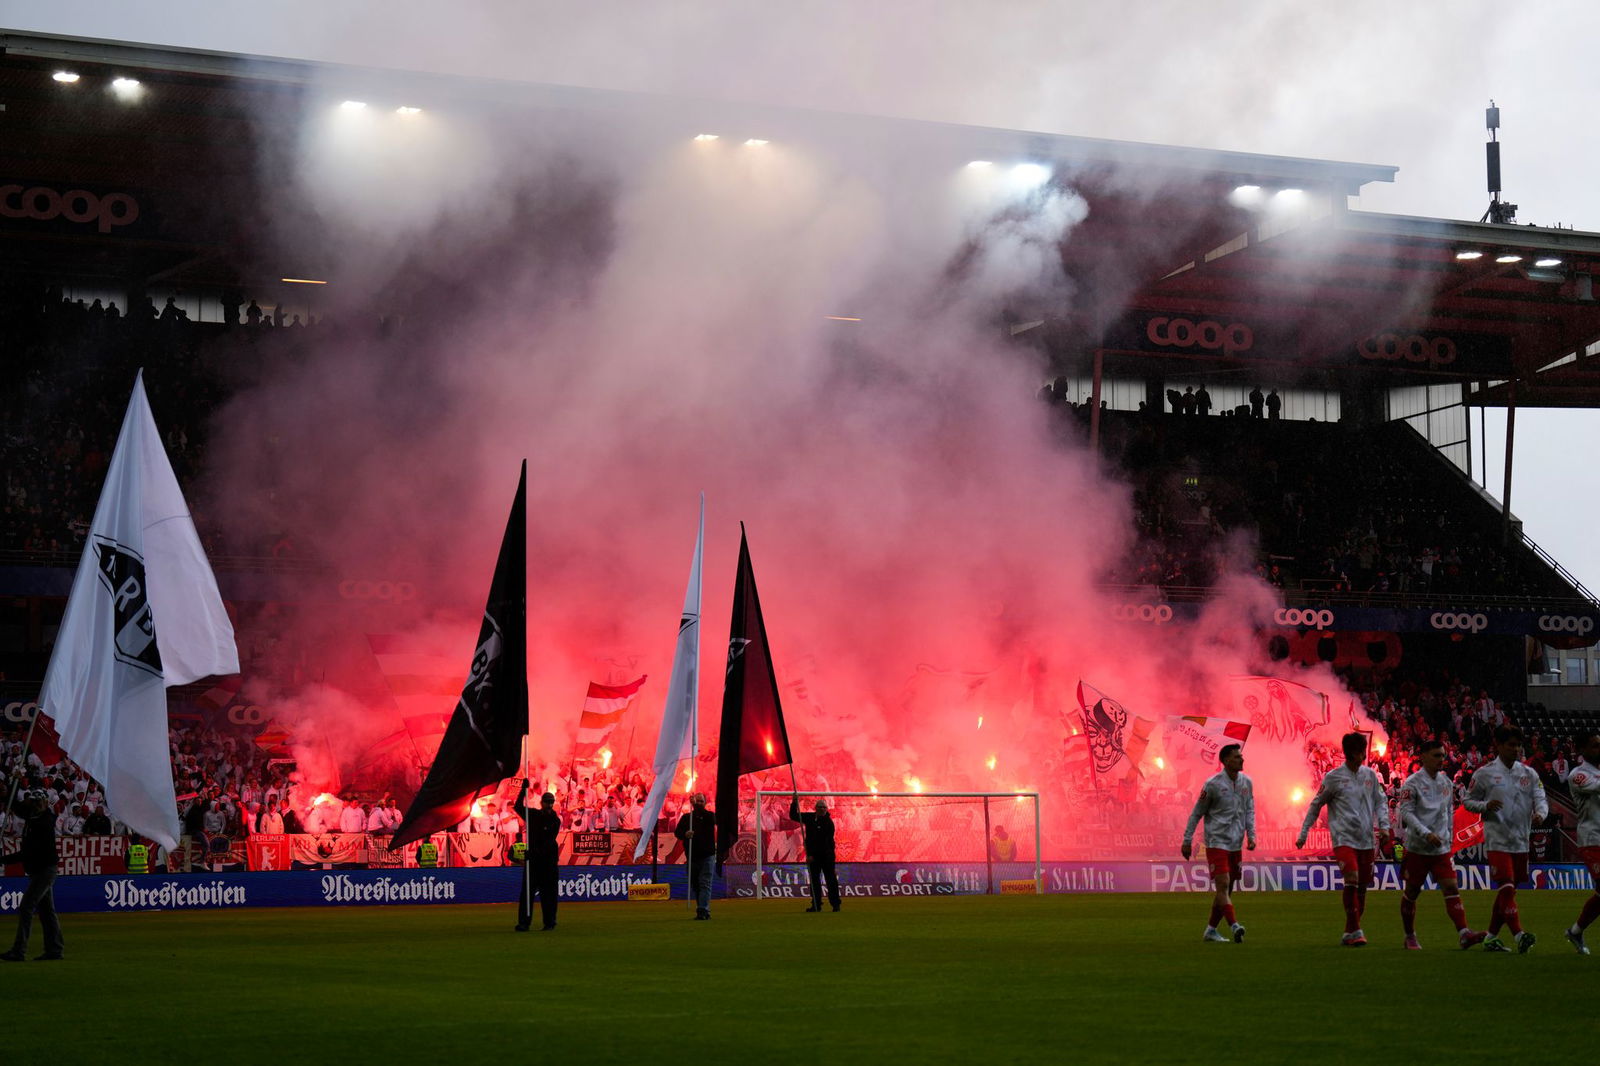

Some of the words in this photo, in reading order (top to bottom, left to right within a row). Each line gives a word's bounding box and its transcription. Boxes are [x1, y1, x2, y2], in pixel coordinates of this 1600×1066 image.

[0, 184, 139, 233] coop
[1147, 317, 1253, 358] coop
[1359, 334, 1456, 368] coop
[1111, 604, 1173, 625] coop
[1274, 608, 1334, 630] coop
[1430, 612, 1489, 634] coop
[1538, 615, 1594, 636] coop
[4, 702, 38, 722] co
[228, 705, 264, 725] co
[1256, 831, 1293, 850] EKTION
[56, 857, 101, 875] GANG
[321, 875, 456, 902] Adresseavisen
[1001, 883, 1036, 892] BYGGMA
[1052, 867, 1115, 891] SALMAR
[1151, 865, 1282, 892] PASON
[1548, 867, 1594, 890] SALMA
[105, 880, 246, 908] Adresseavisen
[800, 885, 873, 897] CNTACT
[880, 883, 932, 896] SPORT
